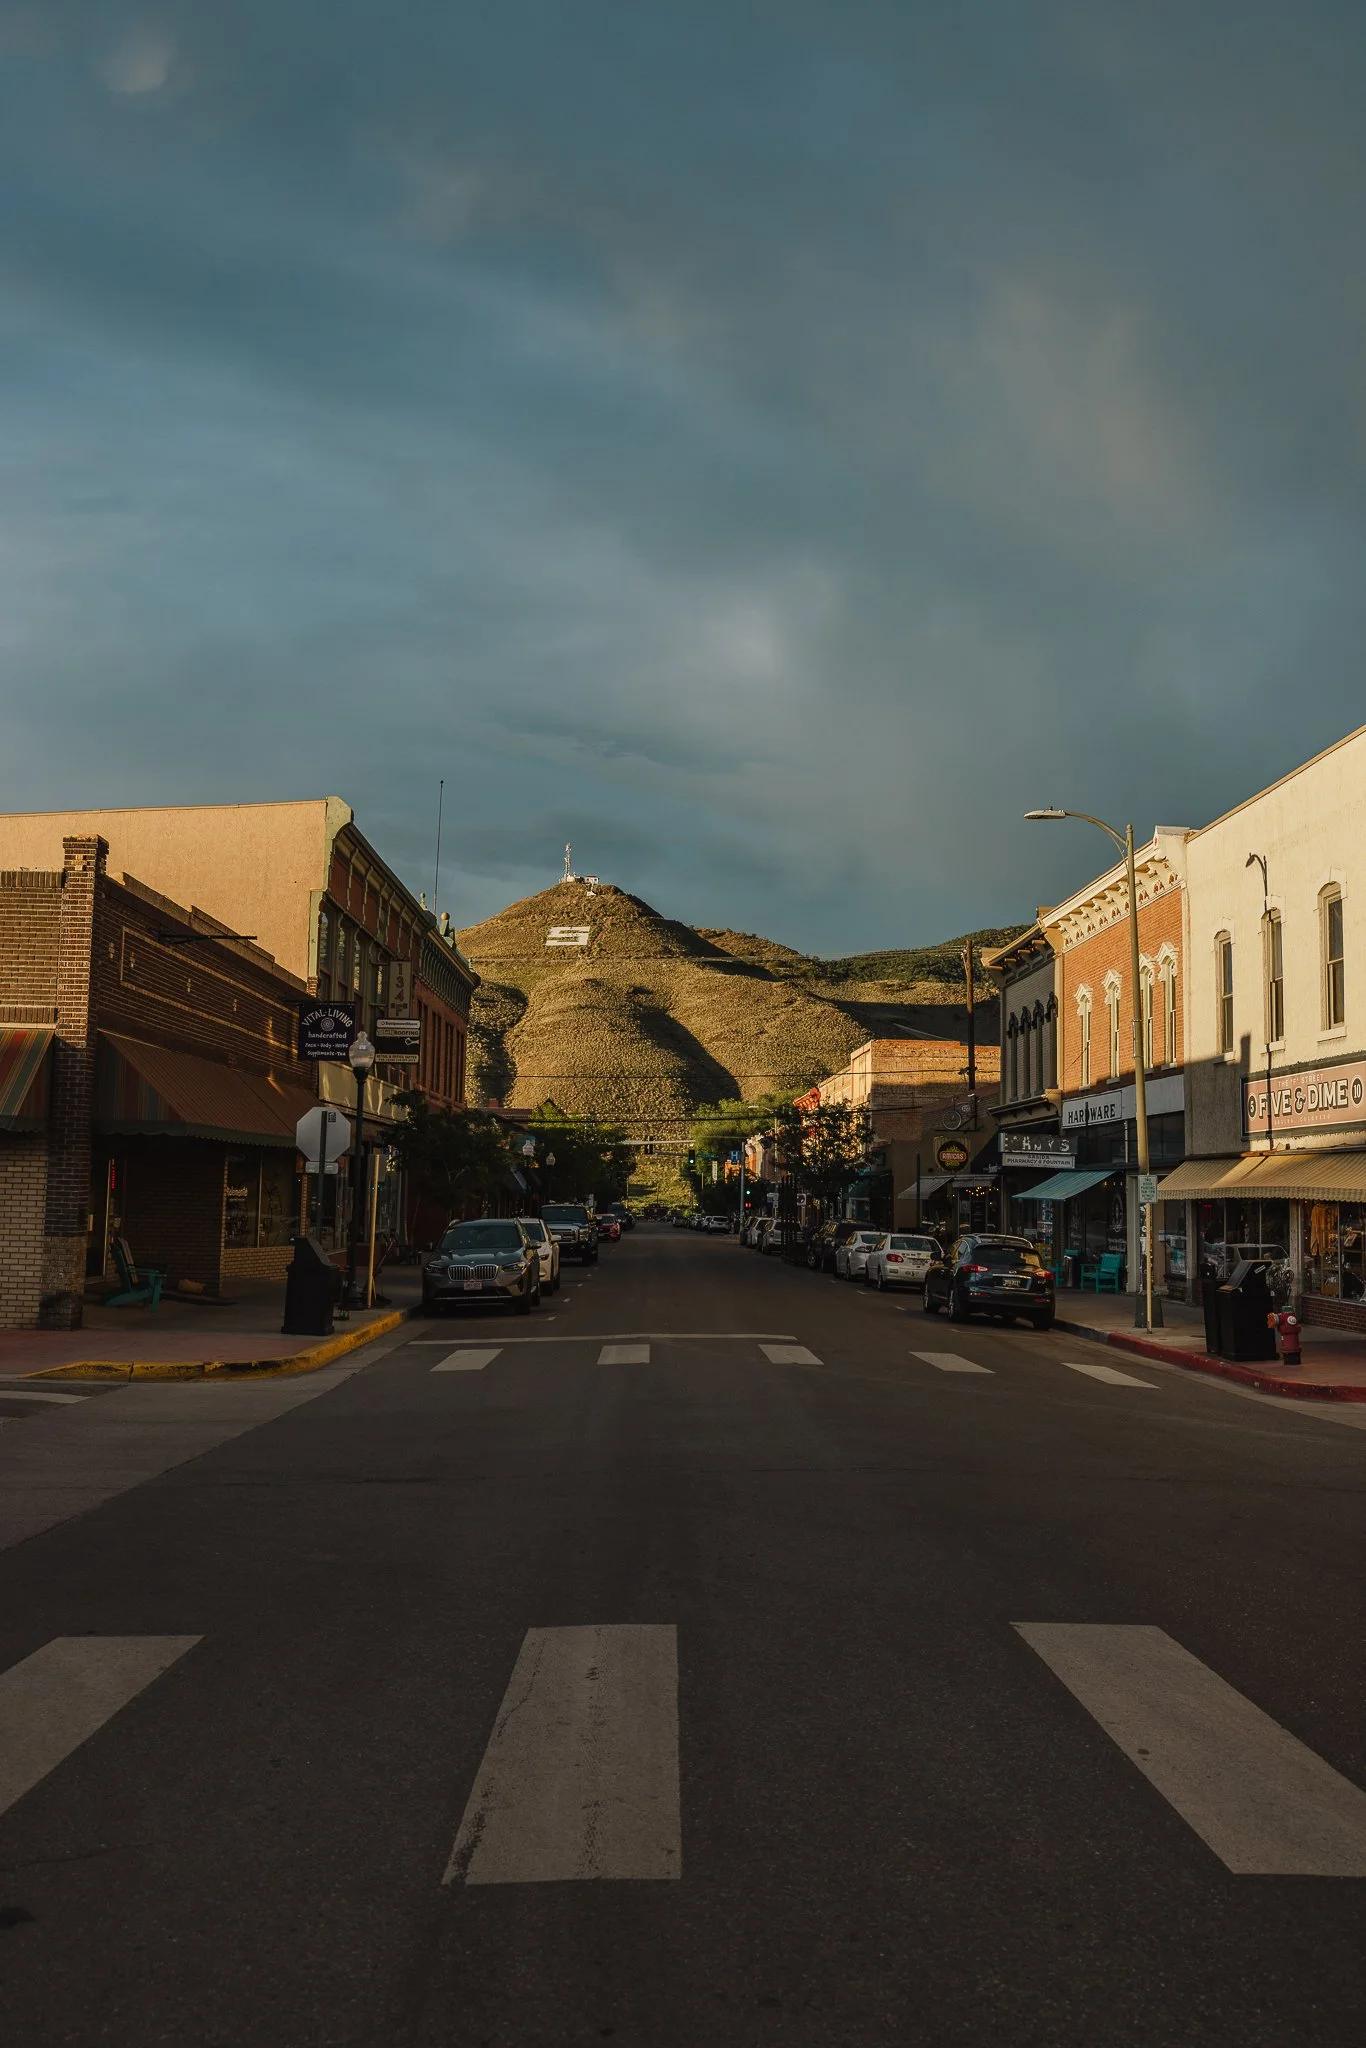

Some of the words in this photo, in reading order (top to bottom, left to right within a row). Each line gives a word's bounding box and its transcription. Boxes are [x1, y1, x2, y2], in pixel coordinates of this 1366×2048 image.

[307, 1031, 347, 1040] handcrafted
[1302, 1073, 1324, 1084] STREET
[1258, 1089, 1292, 1119] FVE
[1307, 1079, 1349, 1112] DIME
[1353, 1083, 1362, 1099] 10
[1068, 1104, 1116, 1124] HARWARE
[731, 1150, 740, 1161] H
